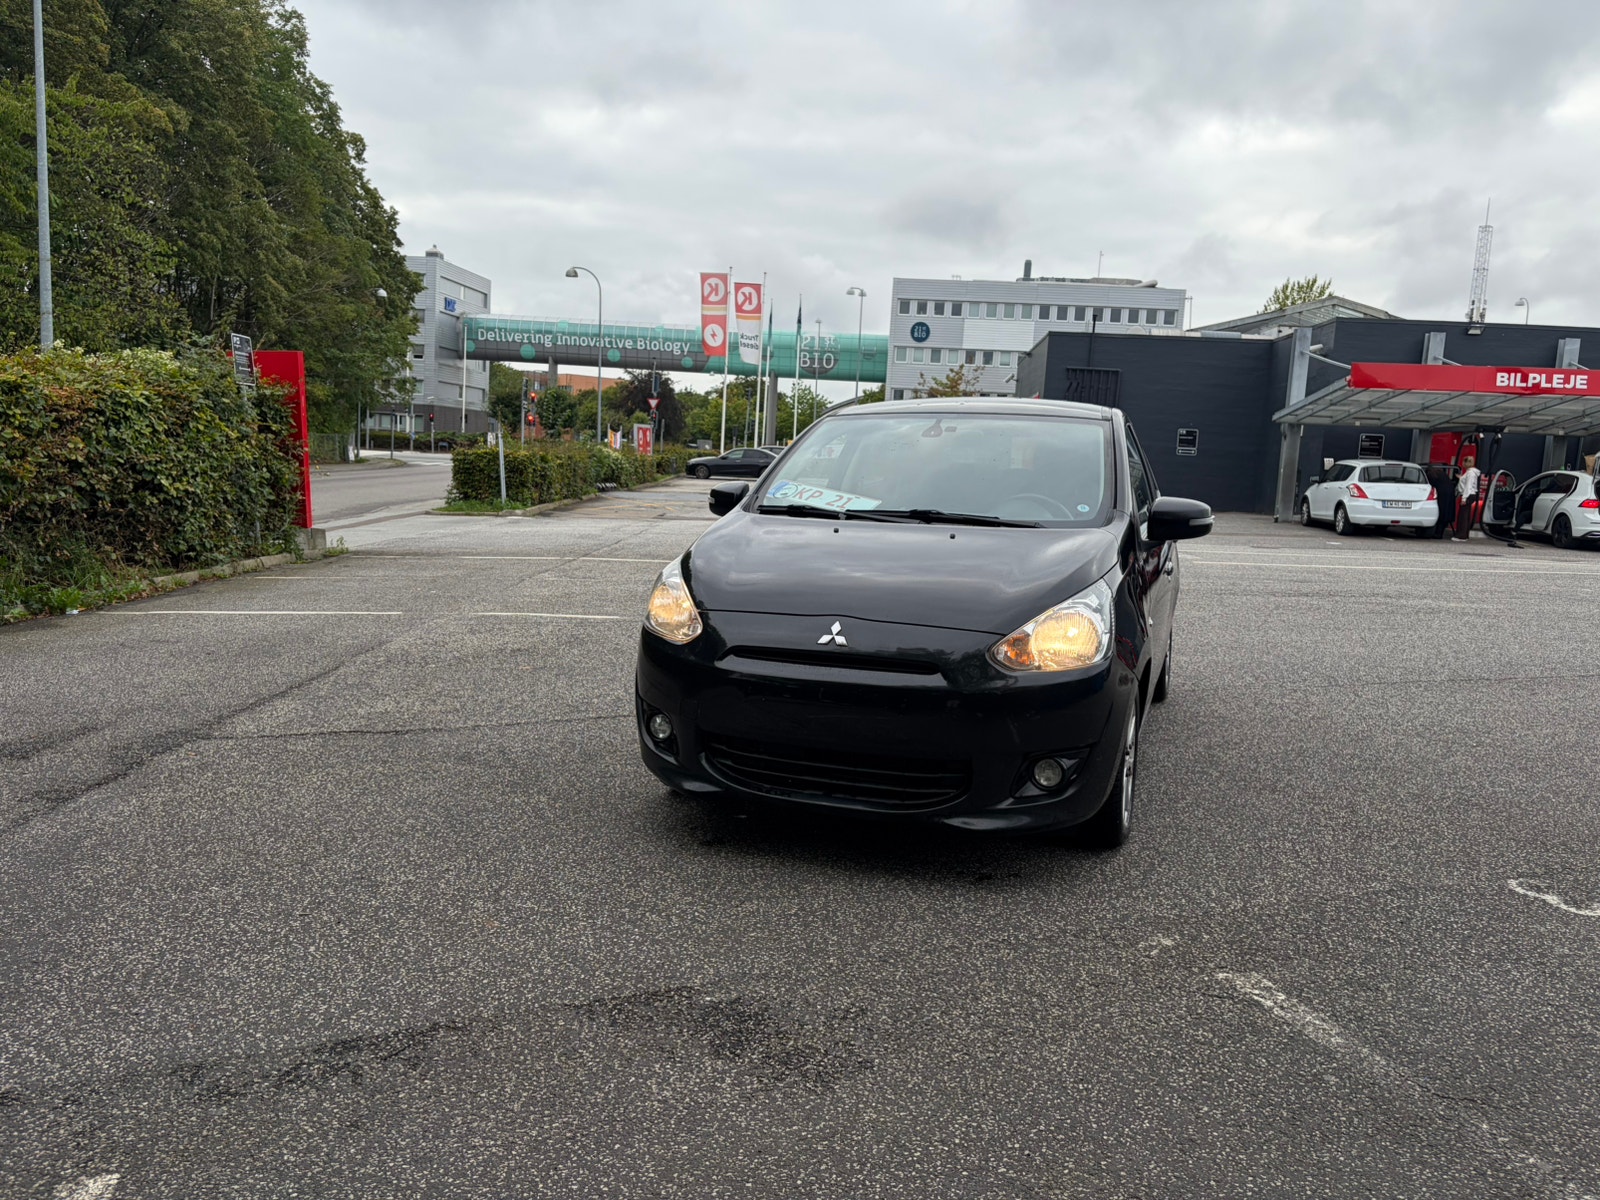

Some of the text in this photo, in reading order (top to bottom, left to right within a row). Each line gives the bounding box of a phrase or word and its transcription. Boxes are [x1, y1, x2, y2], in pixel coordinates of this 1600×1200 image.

[478, 329, 690, 354] Delivering Innovative Biology
[800, 352, 834, 368] BIO
[1496, 372, 1588, 389] BILPLEJE
[794, 487, 823, 501] KP
